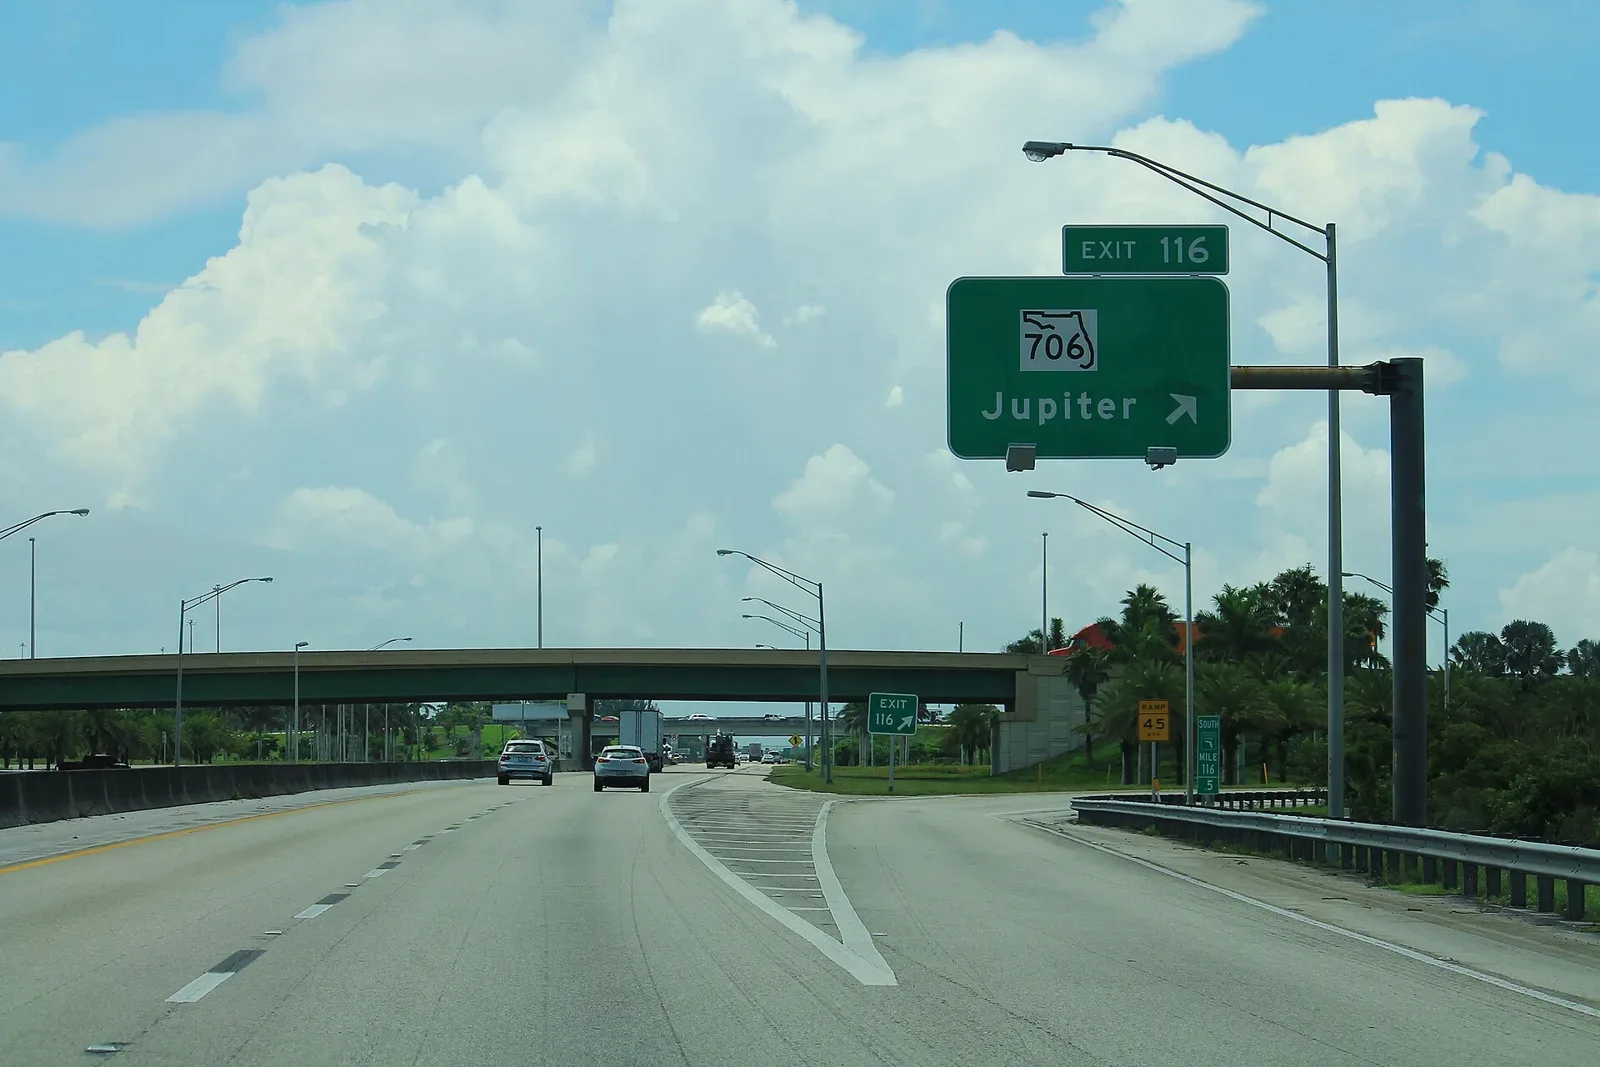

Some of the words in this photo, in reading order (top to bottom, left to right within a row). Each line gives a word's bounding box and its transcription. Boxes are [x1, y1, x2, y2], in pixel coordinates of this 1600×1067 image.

[1082, 241, 1136, 259] EXIT
[1160, 236, 1209, 263] 116
[1024, 332, 1085, 360] 706
[981, 391, 1137, 426] Jupiter
[880, 698, 907, 709] EXIT
[876, 712, 894, 726] 116
[1143, 718, 1165, 730] 45
[1198, 719, 1219, 729] SOUTH
[1199, 752, 1218, 762] MILE
[1202, 763, 1215, 775] 116
